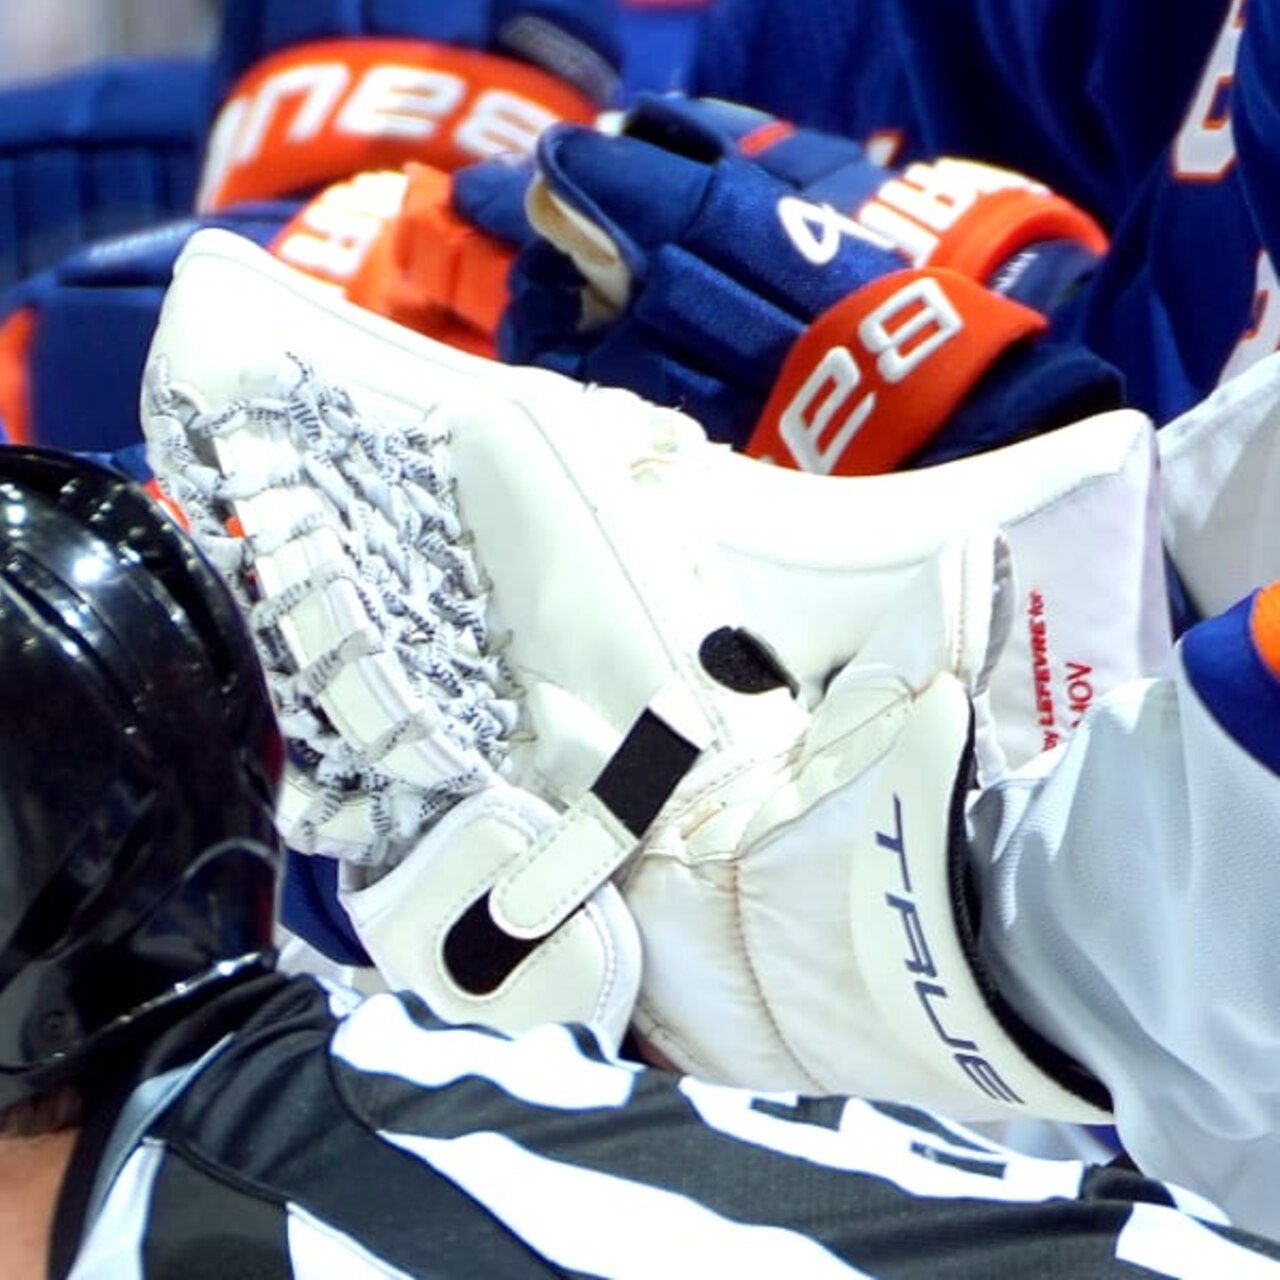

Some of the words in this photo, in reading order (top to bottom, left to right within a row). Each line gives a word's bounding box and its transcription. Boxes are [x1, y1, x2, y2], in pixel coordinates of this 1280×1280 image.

[196, 62, 558, 220] BAU
[756, 275, 965, 477] BA
[875, 792, 1025, 1106] TRUE
